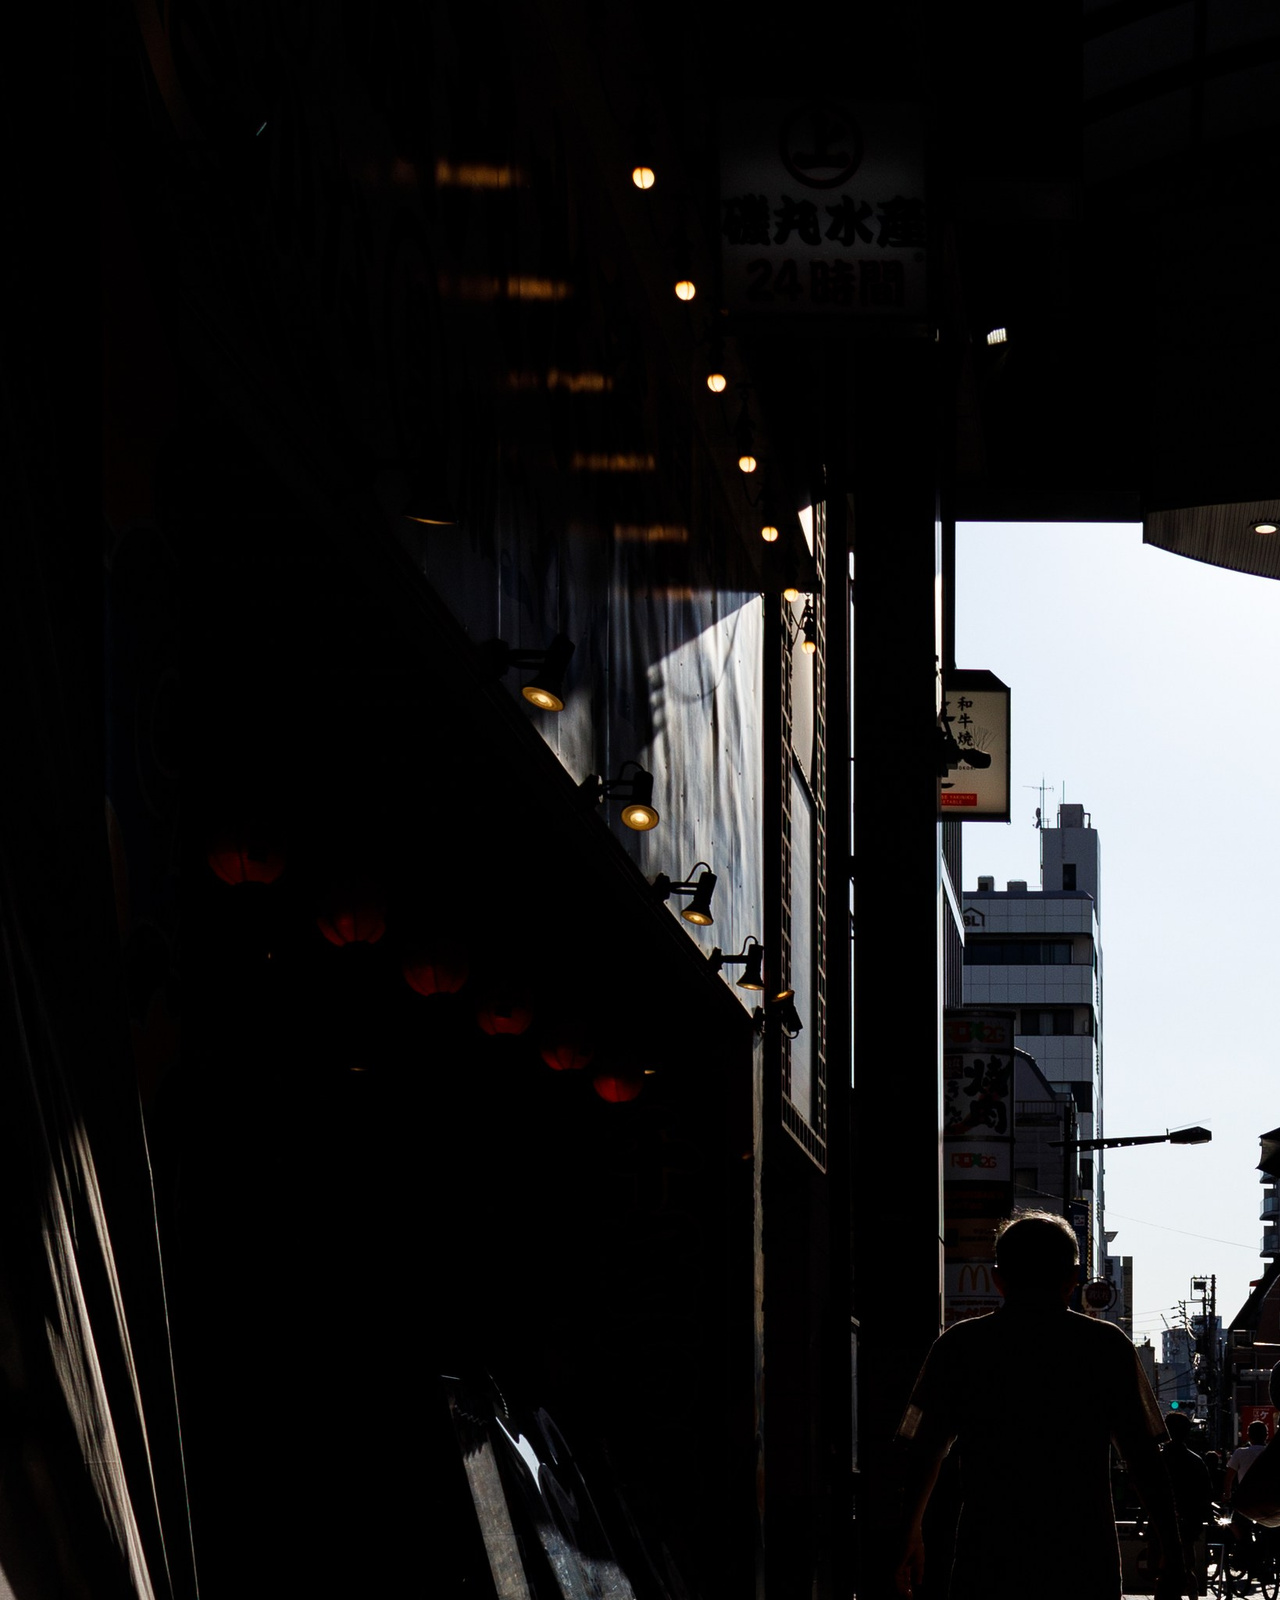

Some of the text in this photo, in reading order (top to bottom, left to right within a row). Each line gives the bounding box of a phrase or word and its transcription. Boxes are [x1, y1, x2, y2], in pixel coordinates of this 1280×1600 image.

[720, 194, 927, 248] 磯丸水産
[746, 259, 904, 307] 24時間
[957, 696, 973, 752] 和牛焼
